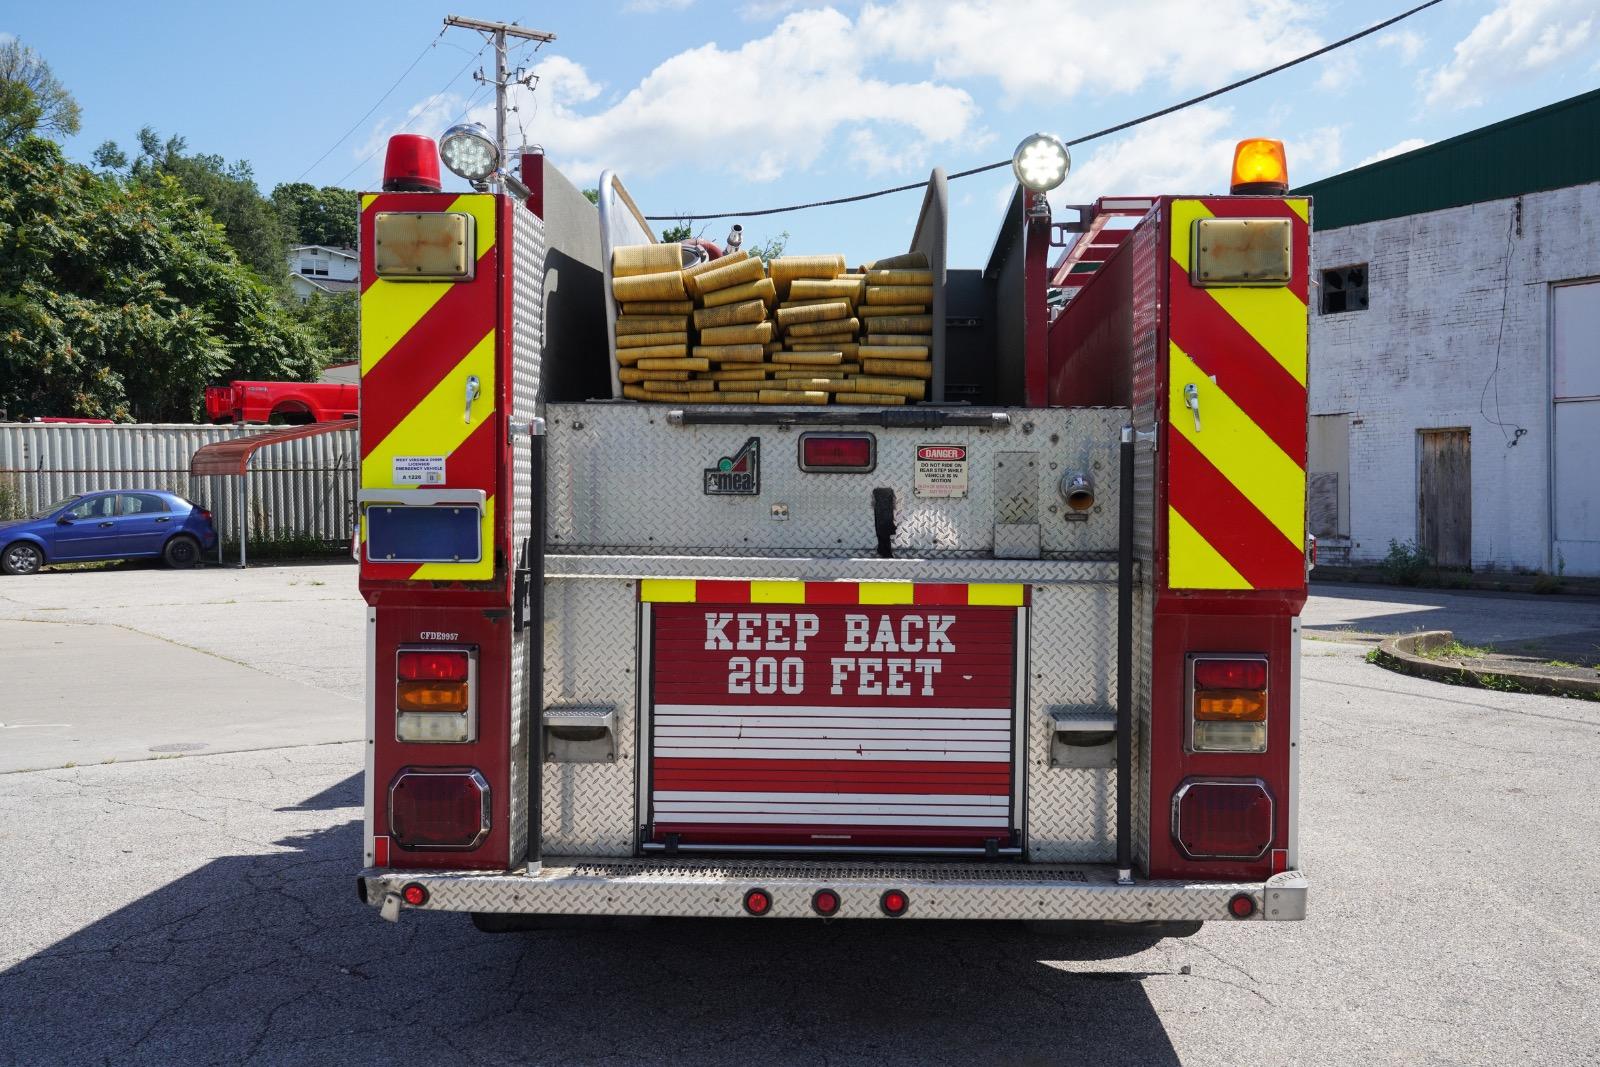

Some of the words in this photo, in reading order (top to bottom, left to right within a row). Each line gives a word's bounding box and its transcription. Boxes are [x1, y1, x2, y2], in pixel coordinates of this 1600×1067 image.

[925, 449, 958, 458] DANGER
[704, 612, 819, 651] KEEP
[844, 614, 956, 653] BACK
[728, 656, 804, 695] 200
[830, 657, 942, 696] FEET
